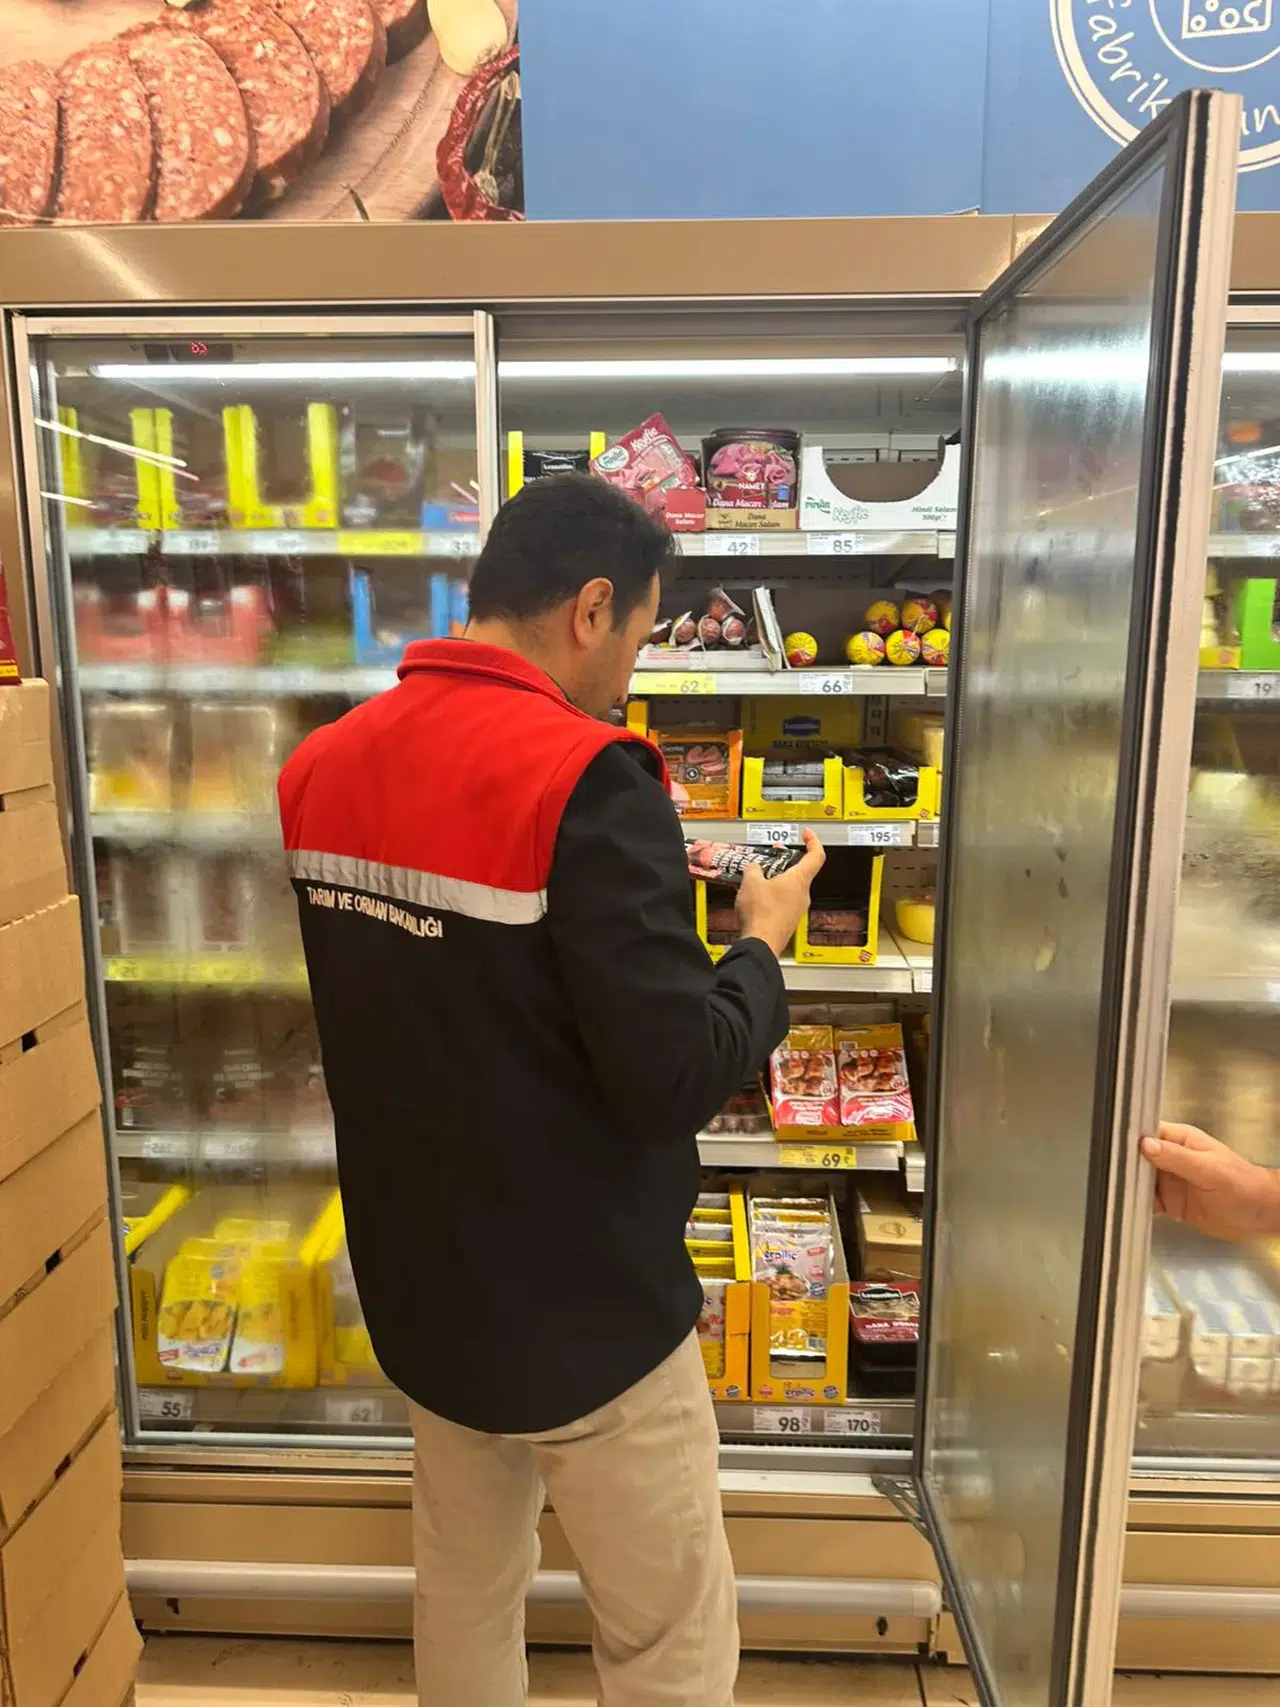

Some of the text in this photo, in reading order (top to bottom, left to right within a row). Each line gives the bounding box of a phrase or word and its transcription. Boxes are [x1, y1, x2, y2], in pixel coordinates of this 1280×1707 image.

[727, 541, 748, 556] 42
[833, 539, 853, 553] 85
[680, 680, 699, 693] 62
[822, 680, 843, 693] 66
[767, 830, 789, 842] 109
[870, 831, 890, 843] 195
[307, 886, 443, 938] TARIM VE ORMAN BAKANLIĞI
[821, 1153, 841, 1167] 69
[161, 1401, 182, 1418] 55
[778, 1416, 800, 1432] 98
[847, 1419, 870, 1432] 170
